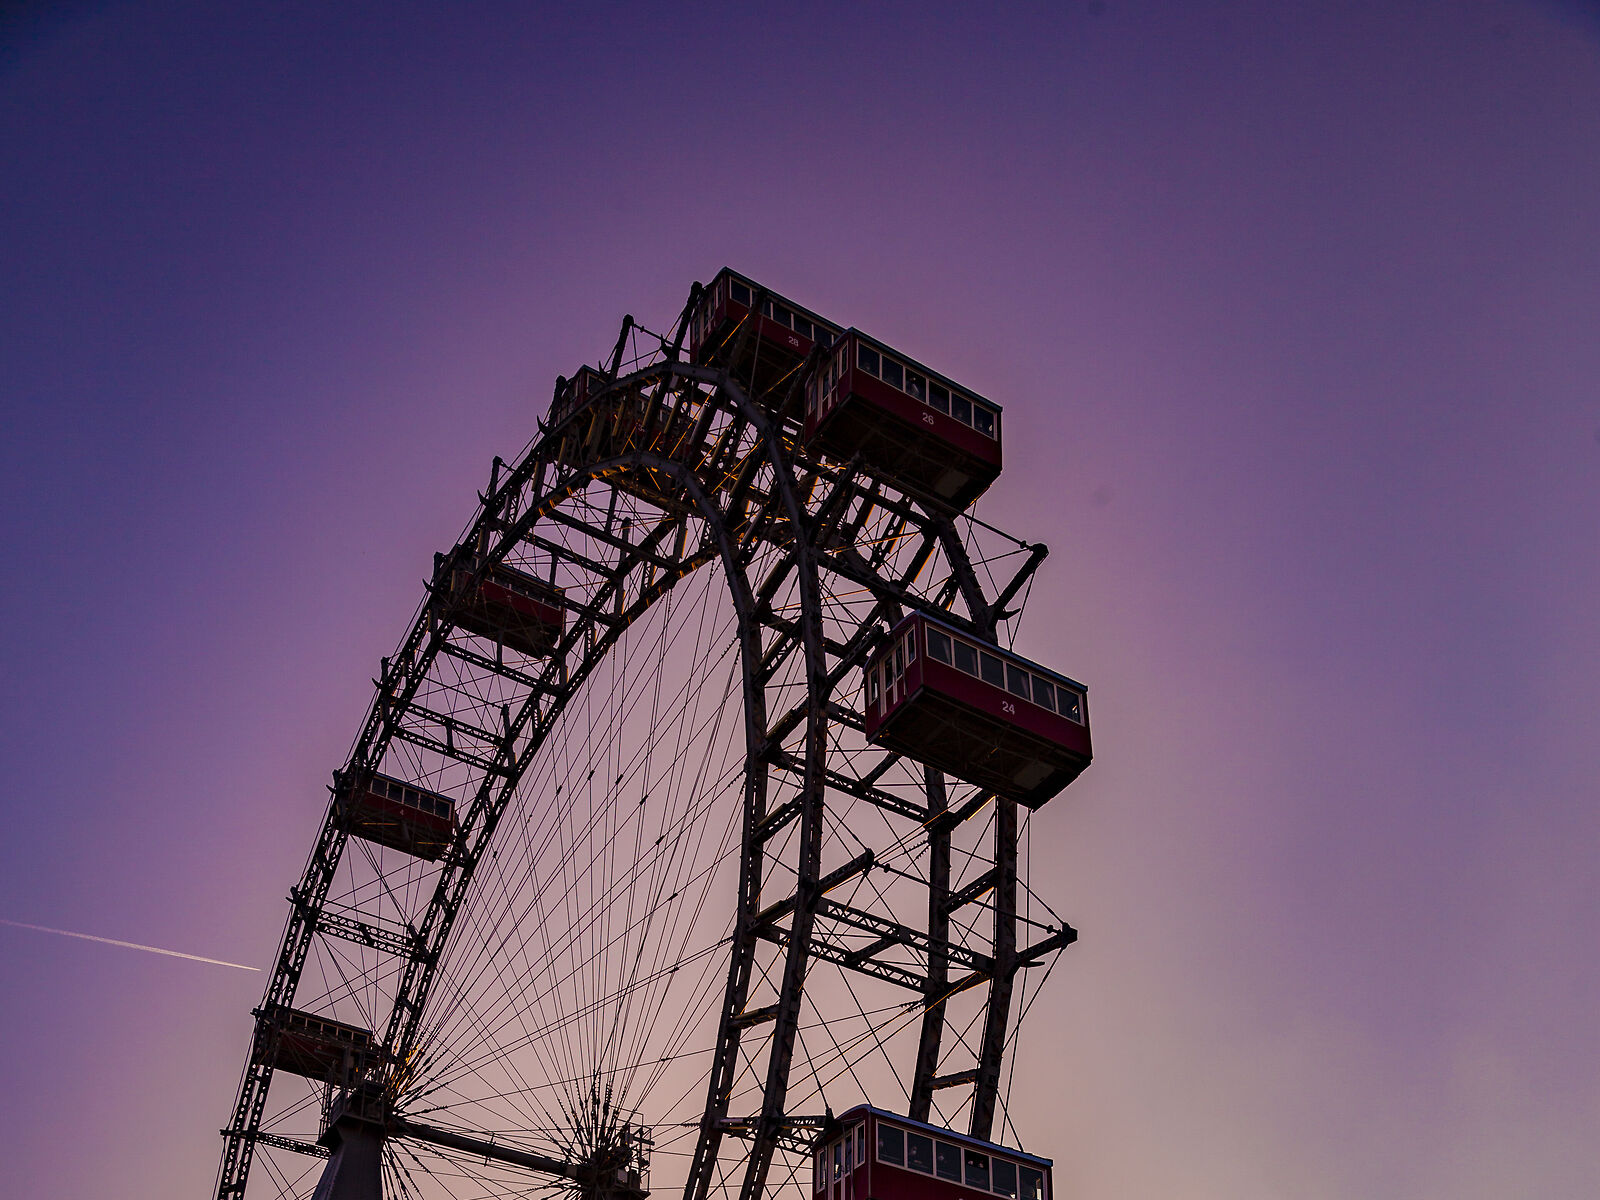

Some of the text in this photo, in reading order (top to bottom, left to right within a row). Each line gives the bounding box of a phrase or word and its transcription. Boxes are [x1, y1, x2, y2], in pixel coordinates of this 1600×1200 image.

[788, 335, 799, 347] 28
[922, 412, 935, 425] 26
[1002, 700, 1016, 715] 24
